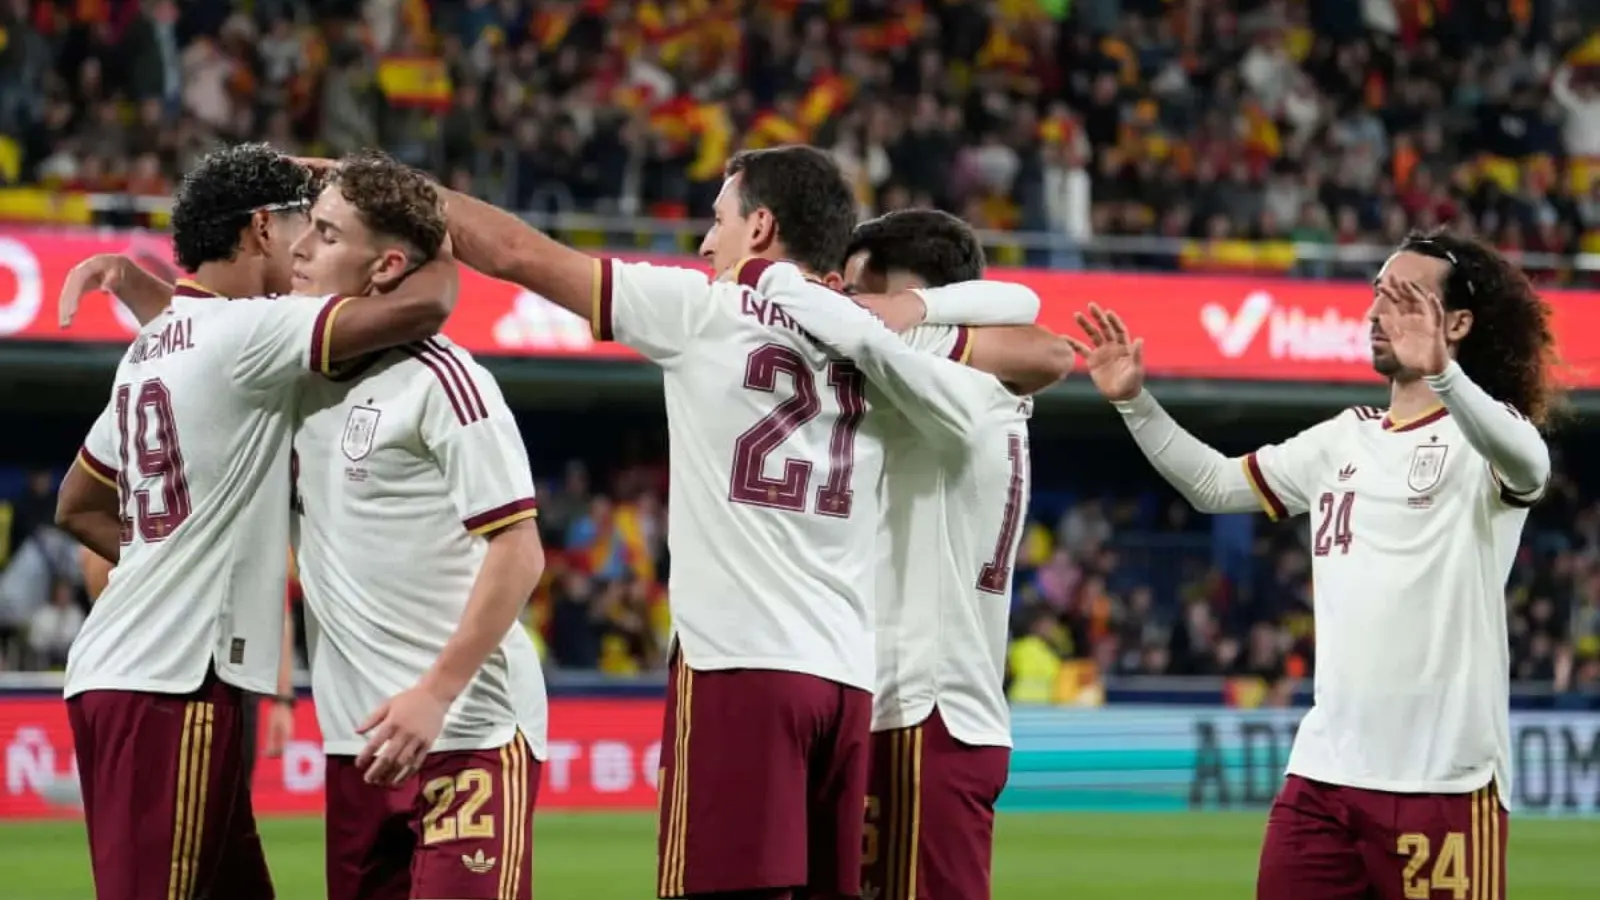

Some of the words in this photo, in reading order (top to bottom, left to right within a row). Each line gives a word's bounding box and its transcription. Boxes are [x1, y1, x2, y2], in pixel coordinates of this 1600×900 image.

[116, 377, 192, 546] 19
[730, 343, 866, 518] 21
[976, 433, 1031, 595] 1
[1315, 491, 1355, 557] 24
[423, 768, 495, 845] 22
[1397, 832, 1469, 899] 24
